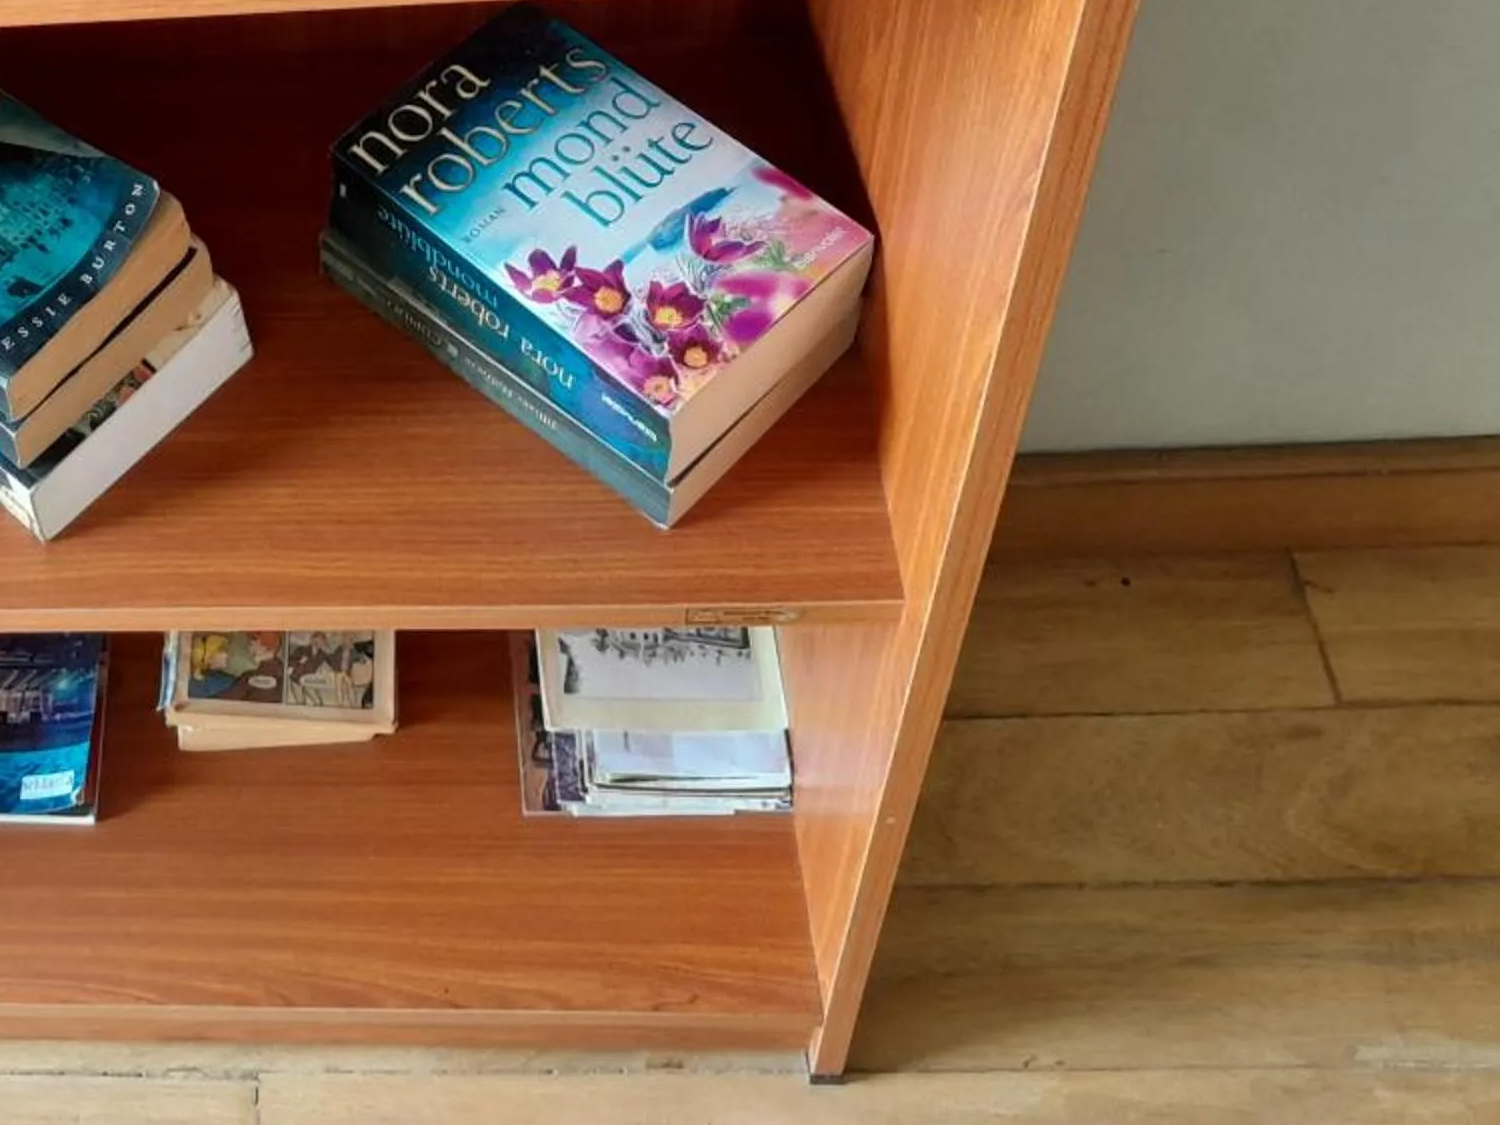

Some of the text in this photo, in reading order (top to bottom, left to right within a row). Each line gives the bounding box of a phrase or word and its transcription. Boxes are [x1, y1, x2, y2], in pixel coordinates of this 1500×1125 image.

[348, 60, 491, 176] nora
[401, 47, 610, 218] roberts
[504, 76, 662, 210] mond
[562, 118, 714, 229] blüte
[80, 184, 144, 284] BURTON
[429, 264, 576, 391] nora roberts
